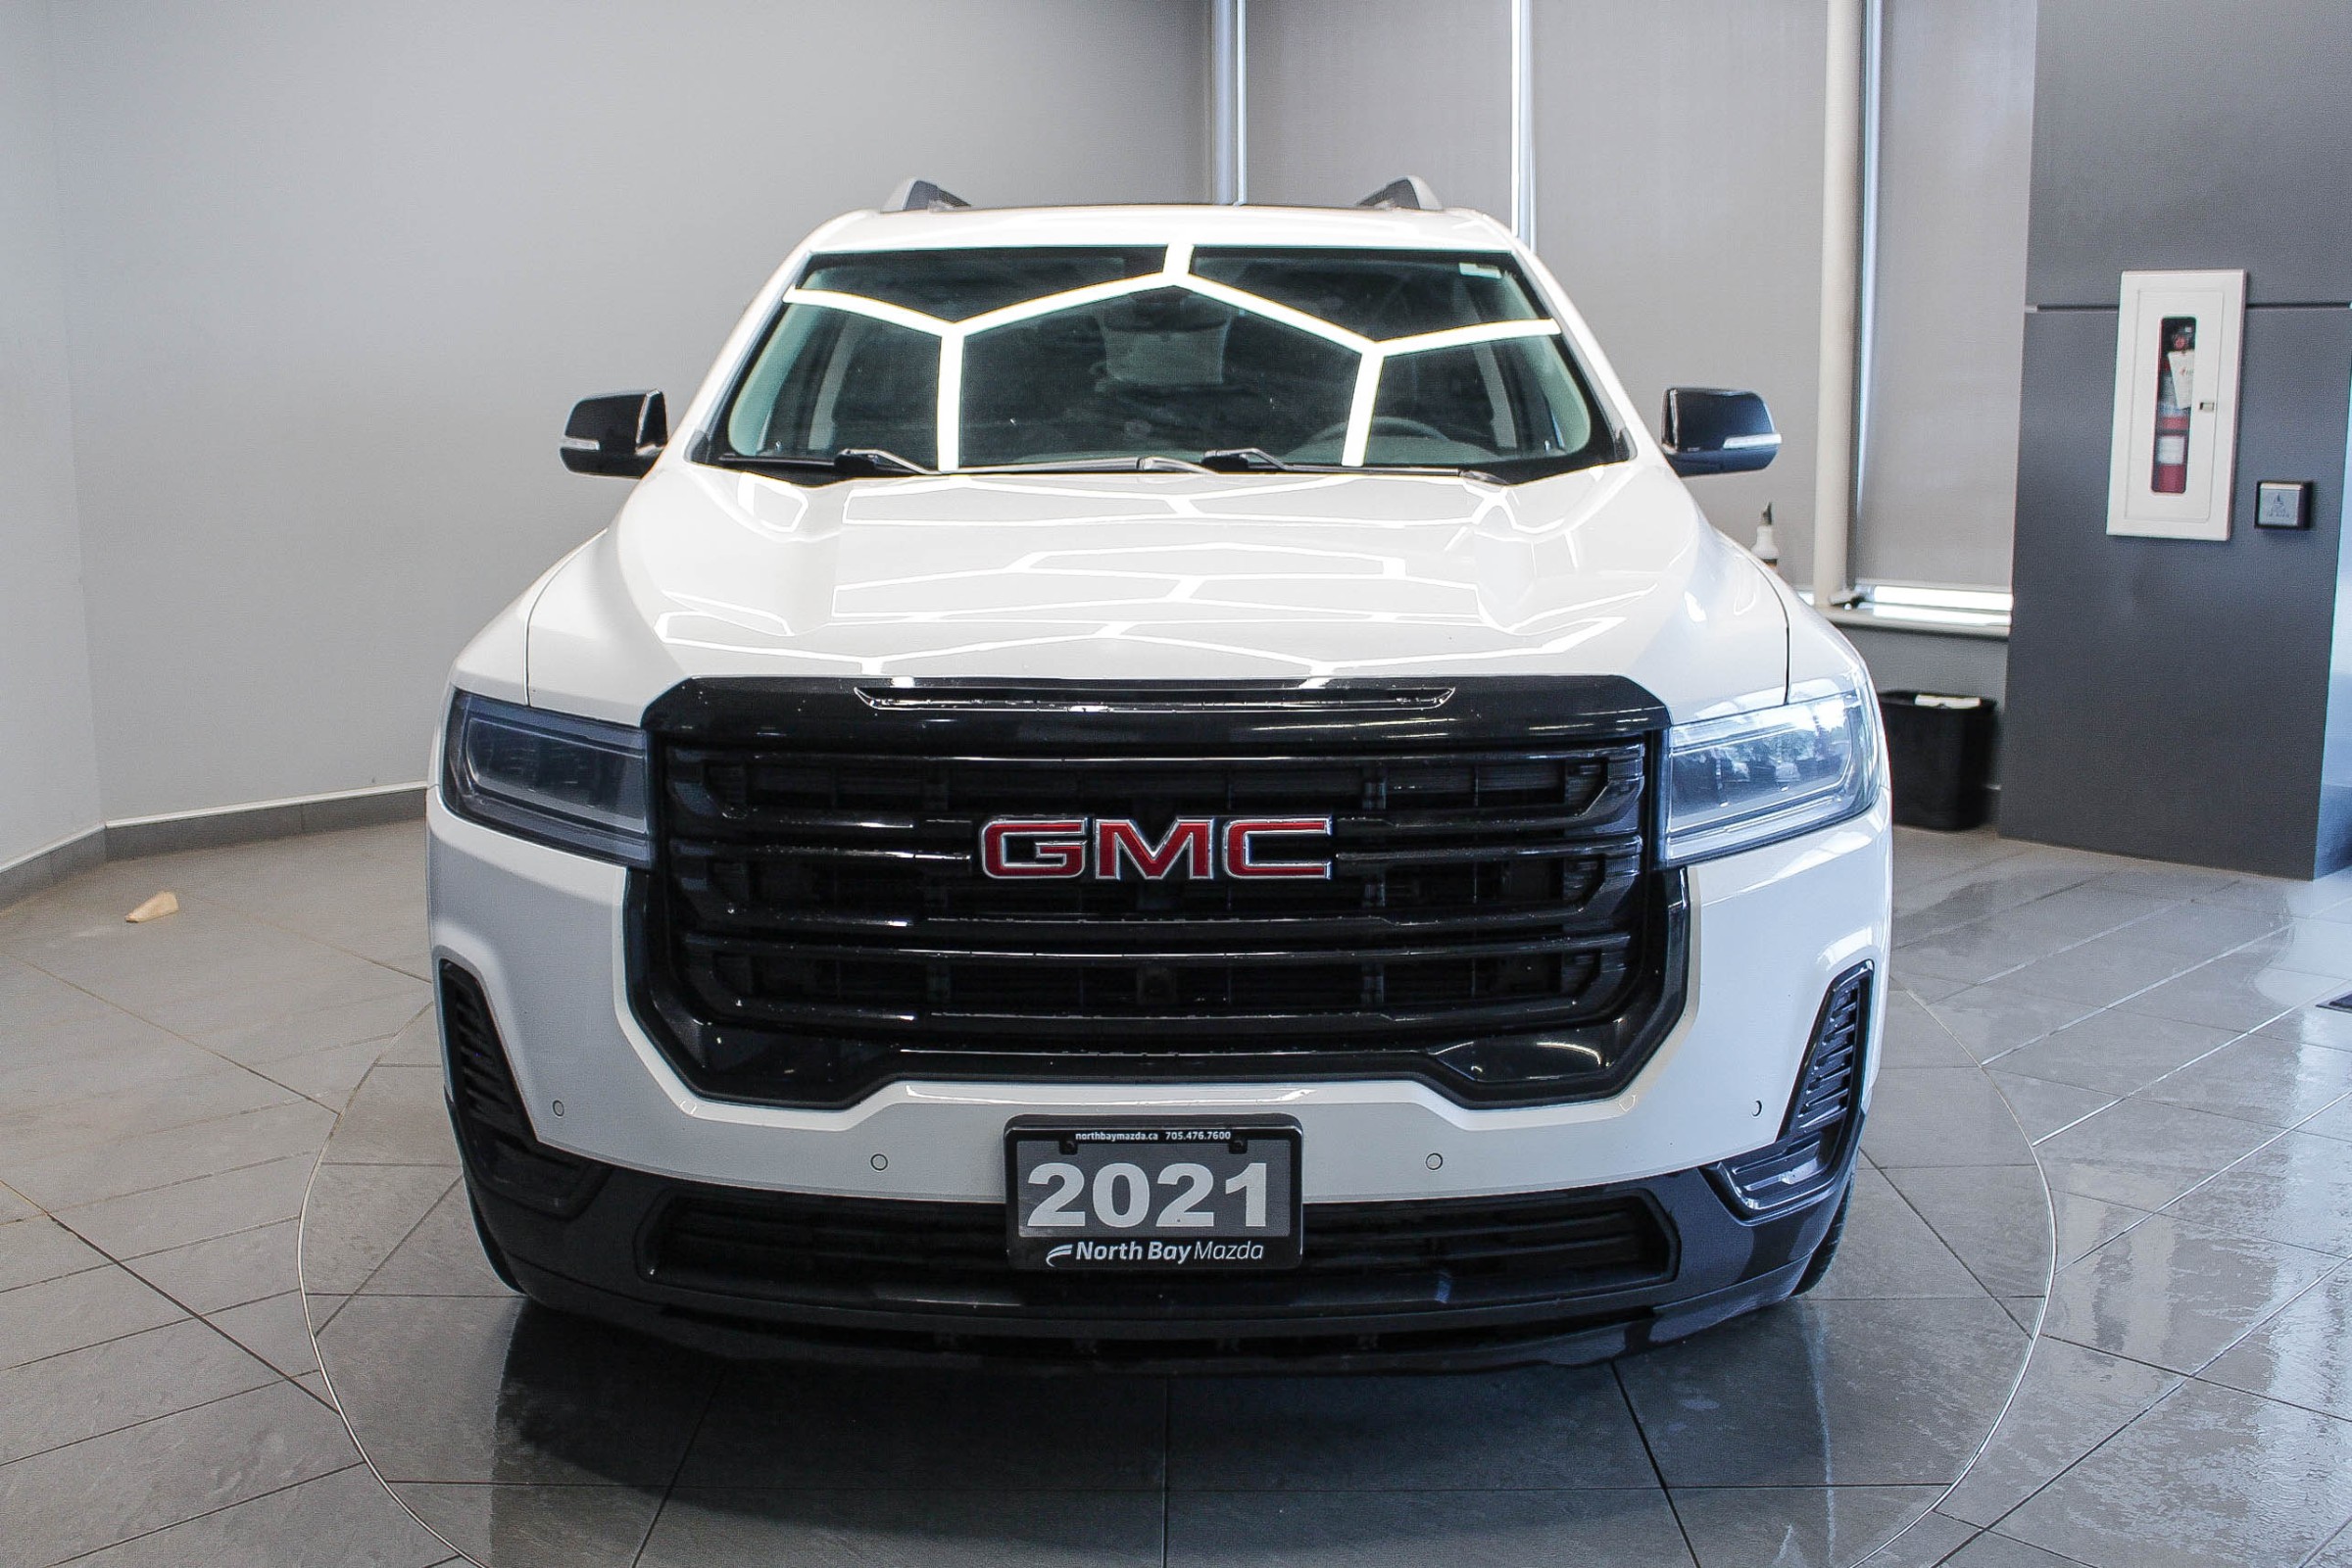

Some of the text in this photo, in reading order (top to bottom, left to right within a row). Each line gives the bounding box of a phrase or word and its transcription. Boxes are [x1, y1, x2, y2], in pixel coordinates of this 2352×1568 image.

[981, 816, 1332, 880] GMC
[1075, 1131, 1231, 1142] northbaymazda.ca 705.476.7600
[1027, 1162, 1266, 1227] 2021
[1076, 1241, 1264, 1264] North Bay Mazda
